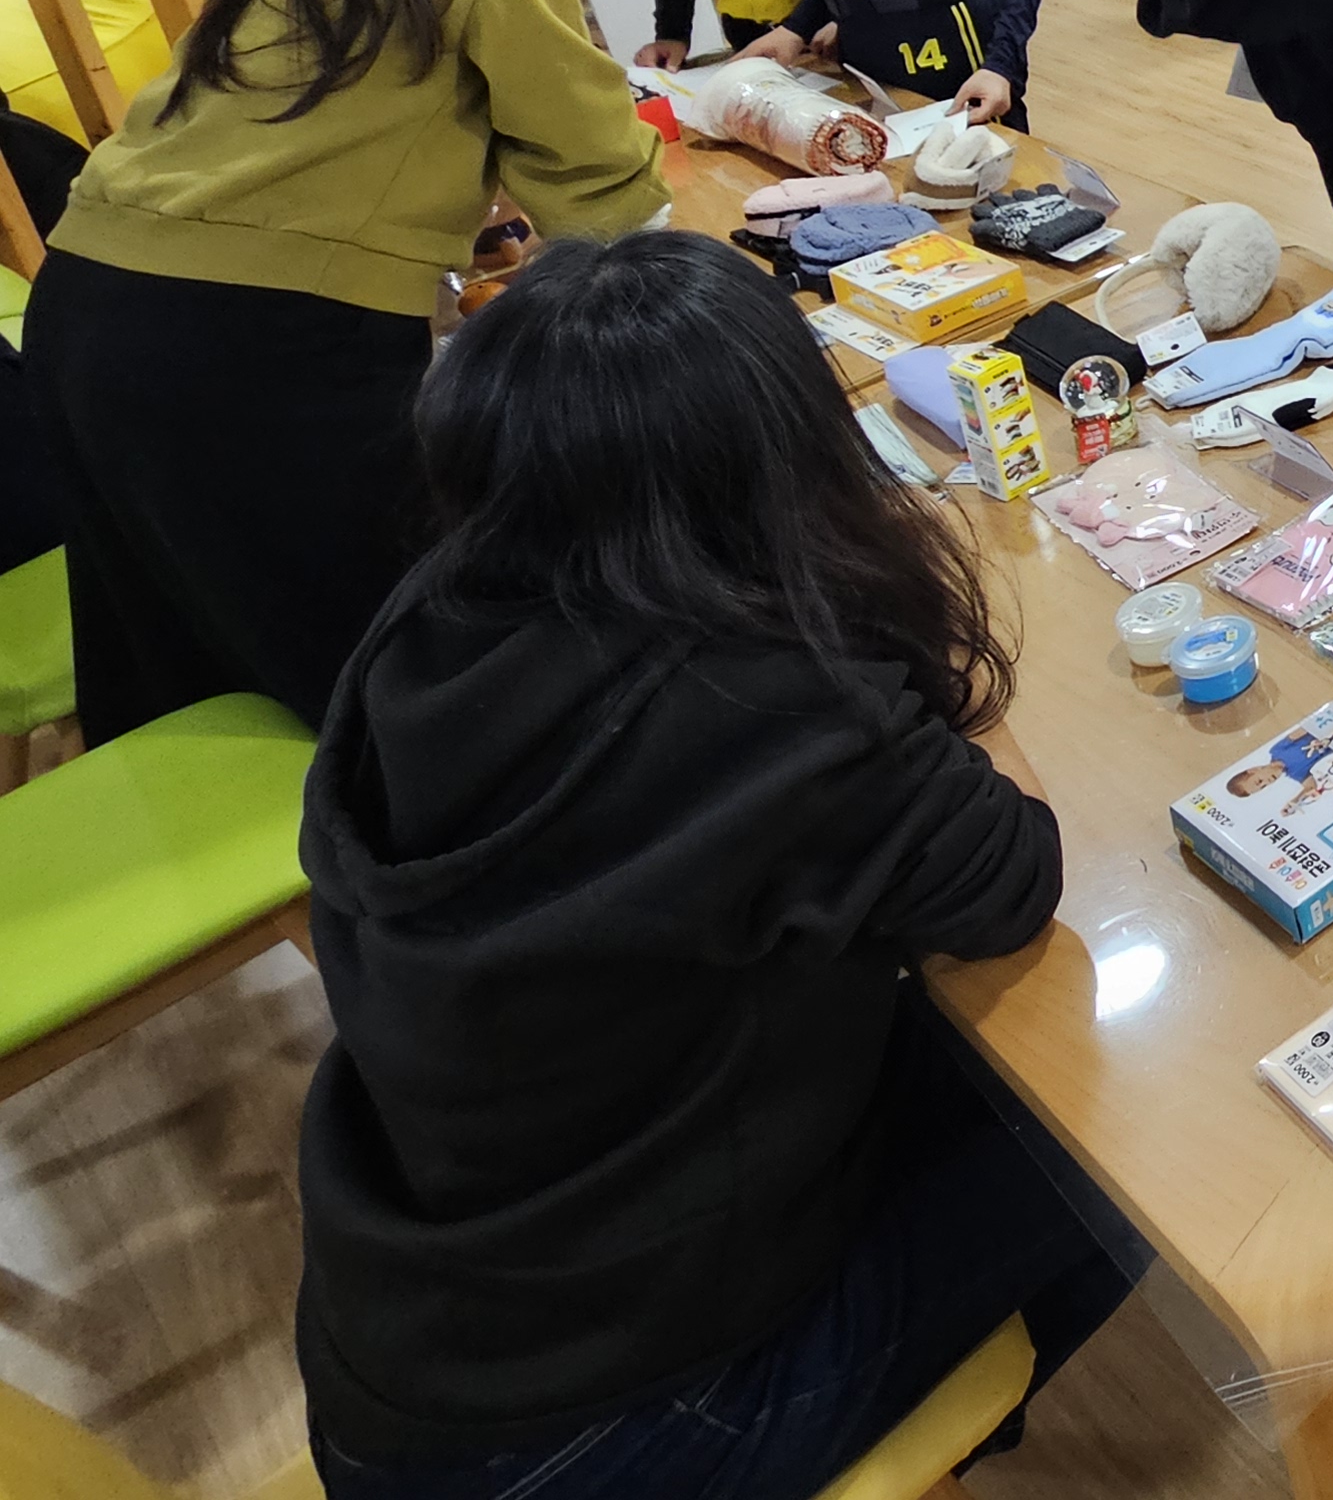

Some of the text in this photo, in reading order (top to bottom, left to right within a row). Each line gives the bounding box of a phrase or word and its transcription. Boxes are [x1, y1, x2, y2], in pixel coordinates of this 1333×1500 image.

[898, 37, 948, 74] 14
[1256, 818, 1331, 877] 균형잡기 놀이
